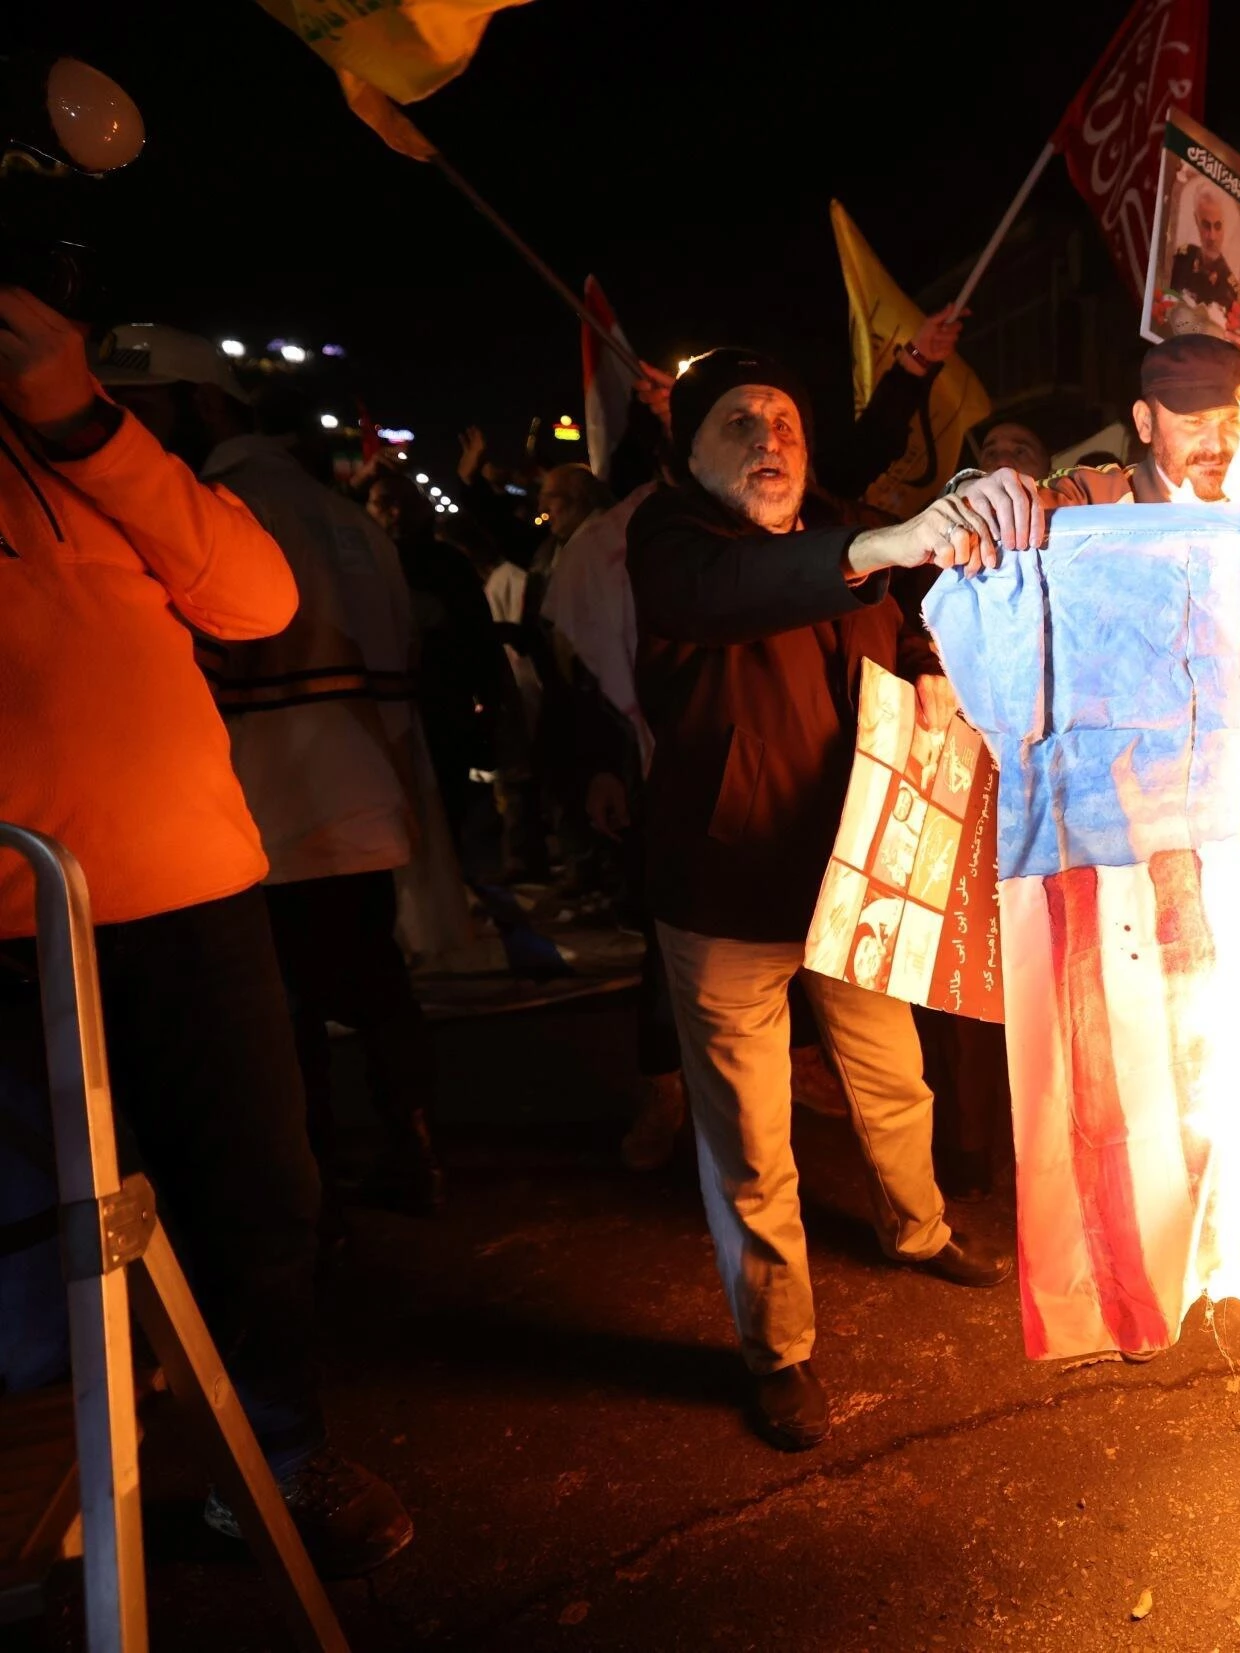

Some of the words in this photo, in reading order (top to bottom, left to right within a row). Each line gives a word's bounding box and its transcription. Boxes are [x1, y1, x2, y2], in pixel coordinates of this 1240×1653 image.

[955, 875, 969, 906] علی
[985, 916, 999, 968] خواهیم
[949, 969, 963, 1012] طالب
[982, 969, 994, 993] کرد
